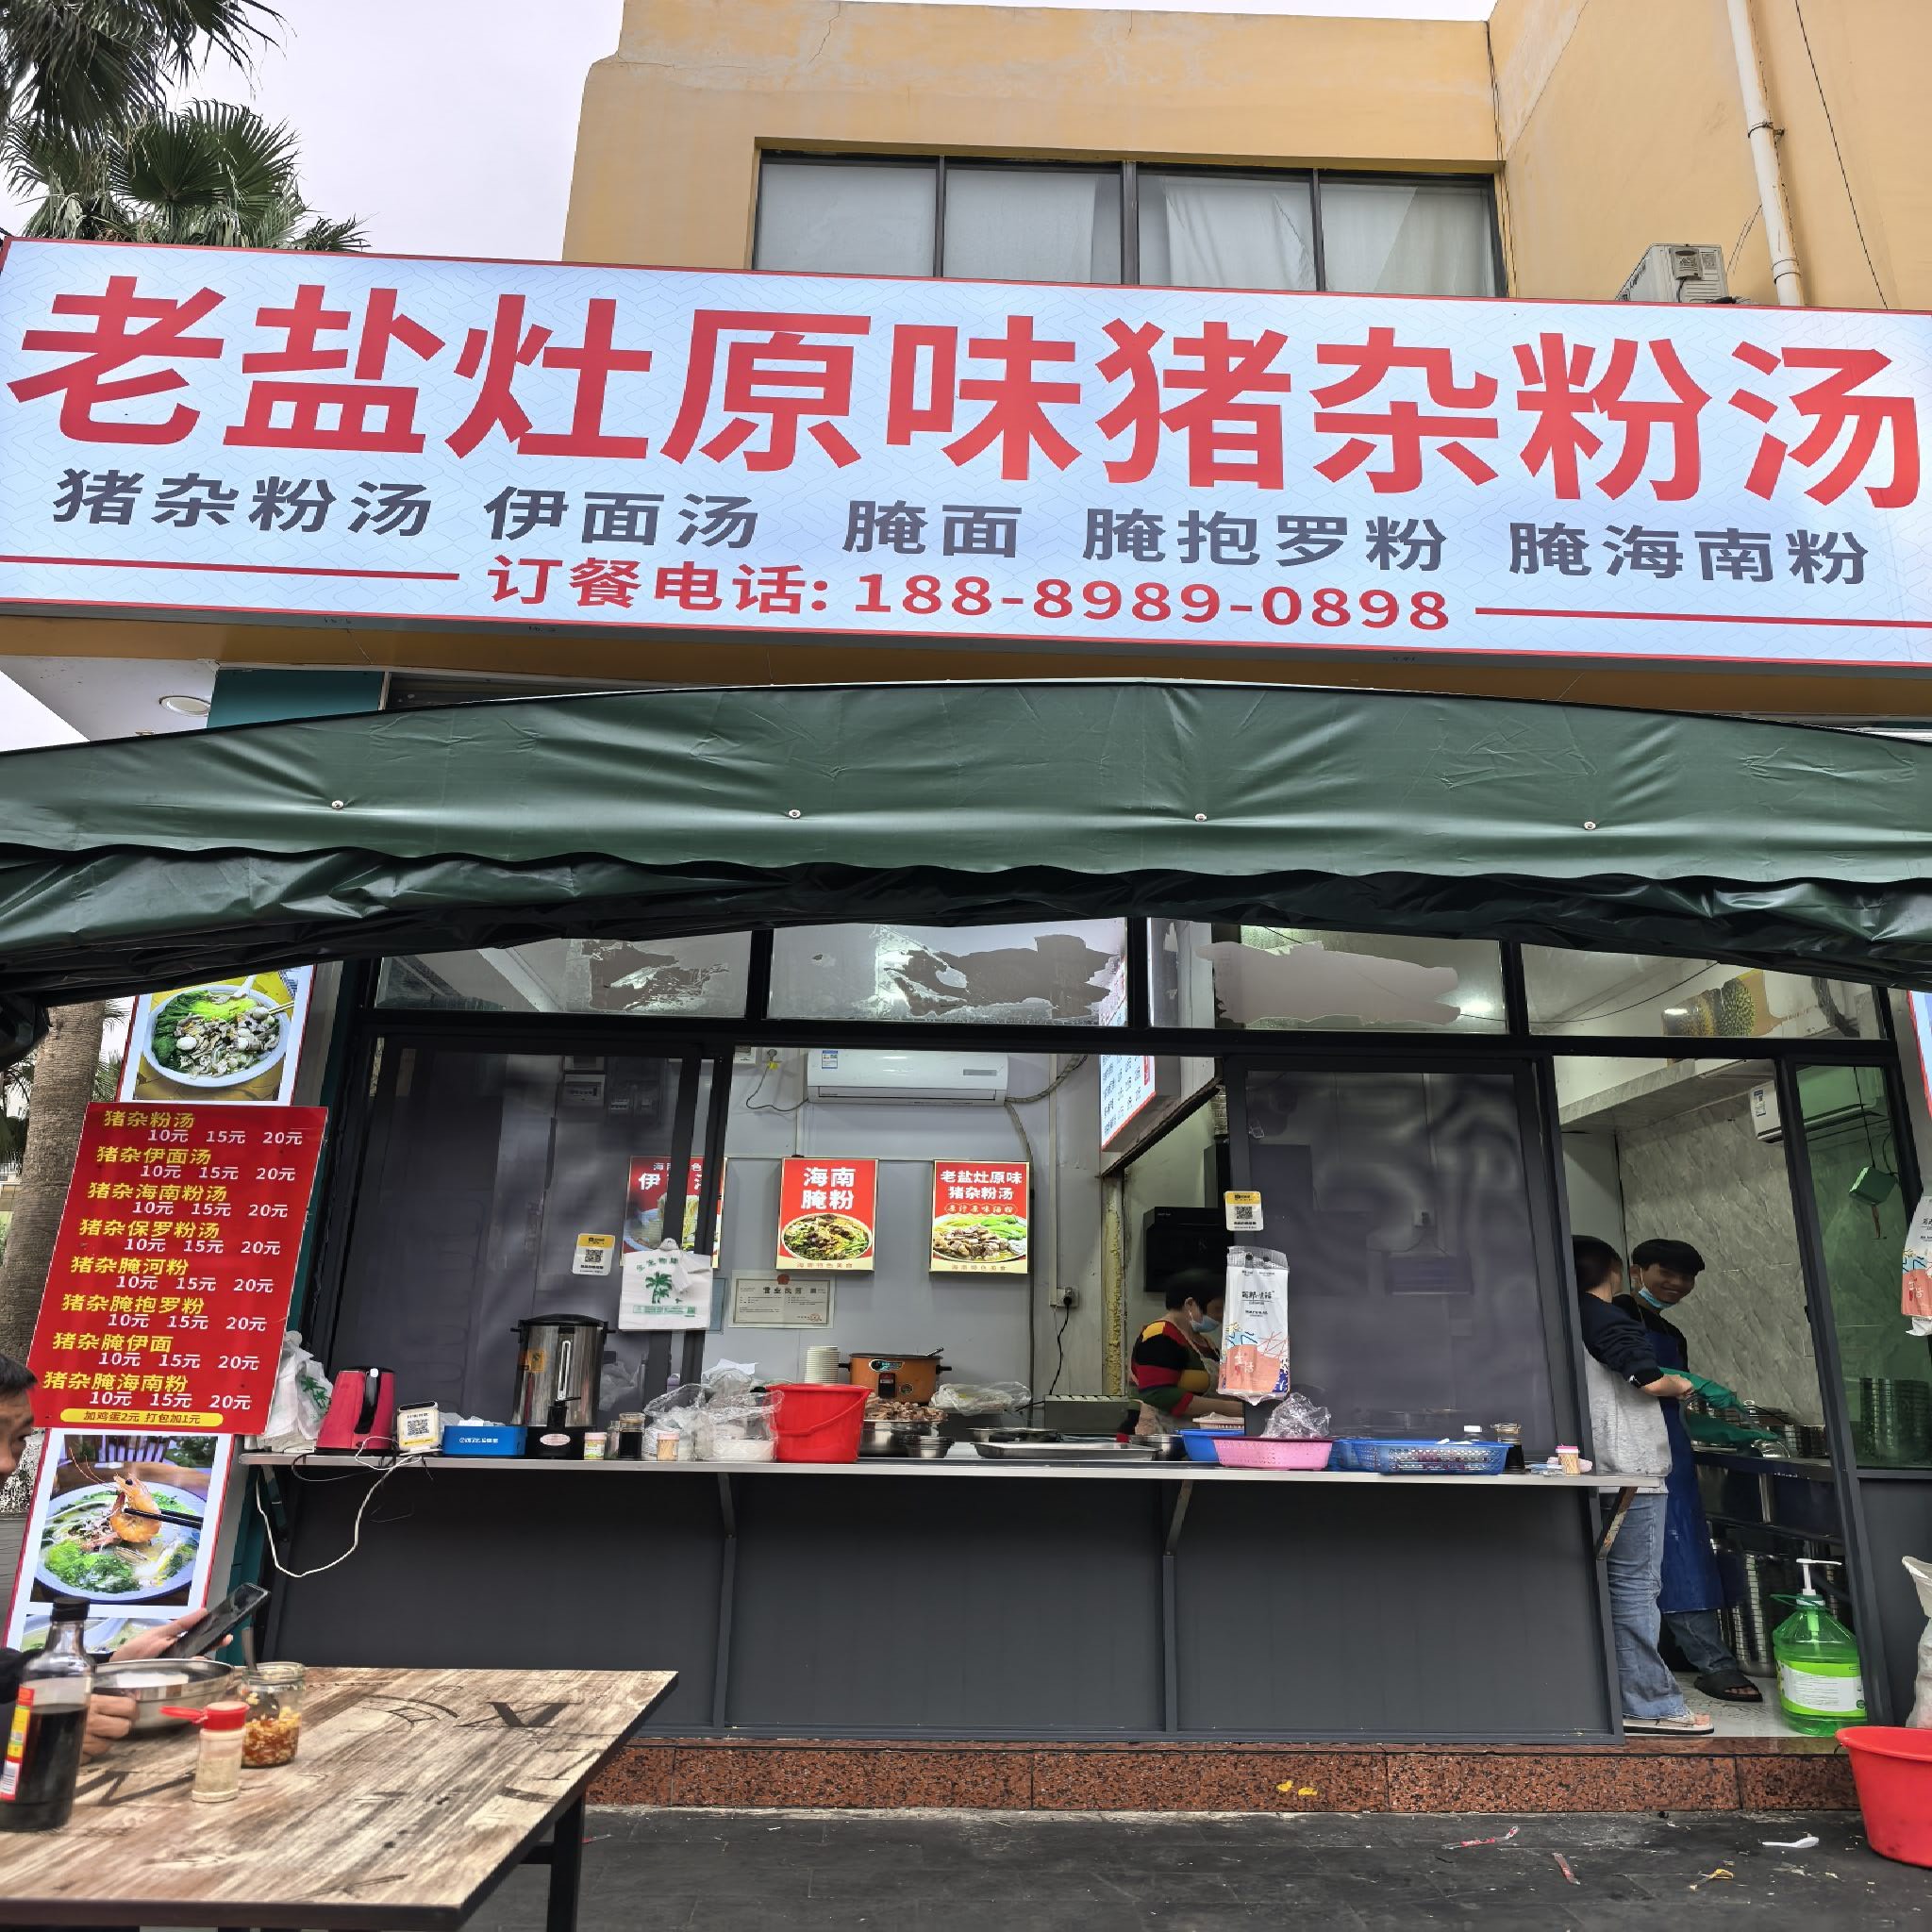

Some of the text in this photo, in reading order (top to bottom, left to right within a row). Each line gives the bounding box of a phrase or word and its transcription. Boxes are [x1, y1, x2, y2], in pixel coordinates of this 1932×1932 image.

[8, 275, 1921, 509] 老盐灶原味猪杂粉汤
[53, 469, 1868, 584] 猪杂粉汤 伊面汤 腌面 腌抱罗粉 腌海南粉
[106, 1111, 193, 1127] 猪杂粉汤
[148, 1130, 302, 1144] 10元 15元 20元
[97, 1147, 210, 1164] 猪杂伊面汤
[141, 1166, 295, 1180] 10元 15元 20元
[803, 1166, 856, 1188] 海南
[940, 1170, 1022, 1184] 老盐灶原味
[89, 1182, 226, 1202] 猪杂海南粉汤
[800, 1189, 854, 1210] 腌粉
[948, 1186, 1014, 1200] 猪杂粉汤
[133, 1202, 288, 1217] 10元 15元 20元
[79, 1219, 219, 1239] 猪杂保罗粉汤
[125, 1239, 280, 1255] 10元 15元 20元
[71, 1257, 189, 1275] 猪杂腌河粉
[117, 1276, 273, 1292] 10元 15元 20元
[61, 1294, 204, 1314] 猪杂腌抱罗粉
[108, 1314, 266, 1331] 10元 15元 20元
[53, 1333, 172, 1353] 猪杂腌伊面
[99, 1353, 259, 1370] 10元 15元 20元
[42, 1372, 187, 1392] 猪杂腌海南粉
[90, 1391, 250, 1409] 10元 15元 20元
